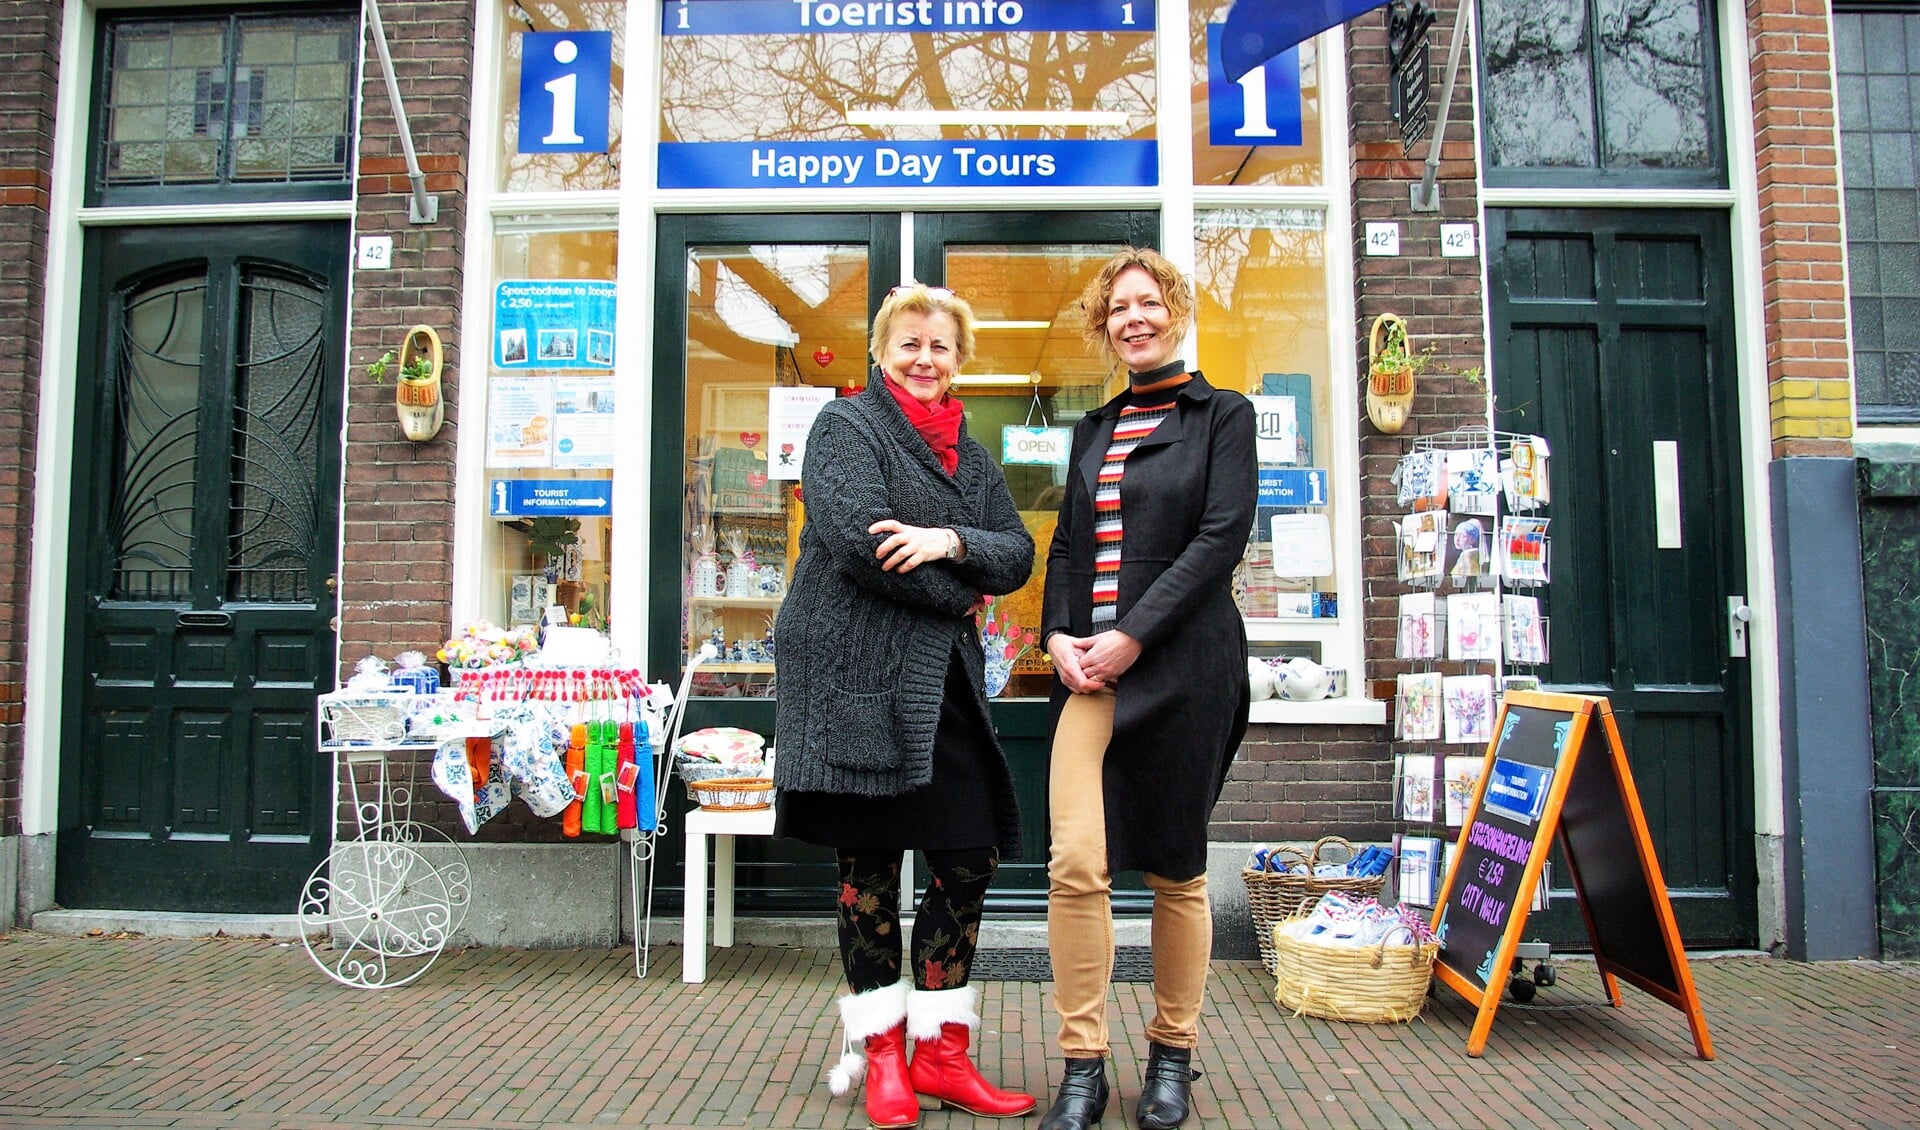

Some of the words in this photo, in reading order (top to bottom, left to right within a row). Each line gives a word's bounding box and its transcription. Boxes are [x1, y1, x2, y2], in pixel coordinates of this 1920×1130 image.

[798, 0, 932, 27] Toerist
[943, 0, 1013, 26] info
[751, 148, 864, 184] Happy
[875, 147, 942, 184] Day
[953, 147, 1056, 177] Tours
[366, 245, 383, 260] 42
[1018, 440, 1056, 453] OPEN
[1258, 479, 1283, 487] URIST
[534, 489, 569, 497] TOURIST
[523, 498, 579, 507] INFORMATION
[1478, 857, 1489, 878] €
[1460, 882, 1484, 912] CITY
[1479, 893, 1506, 926] WALK
